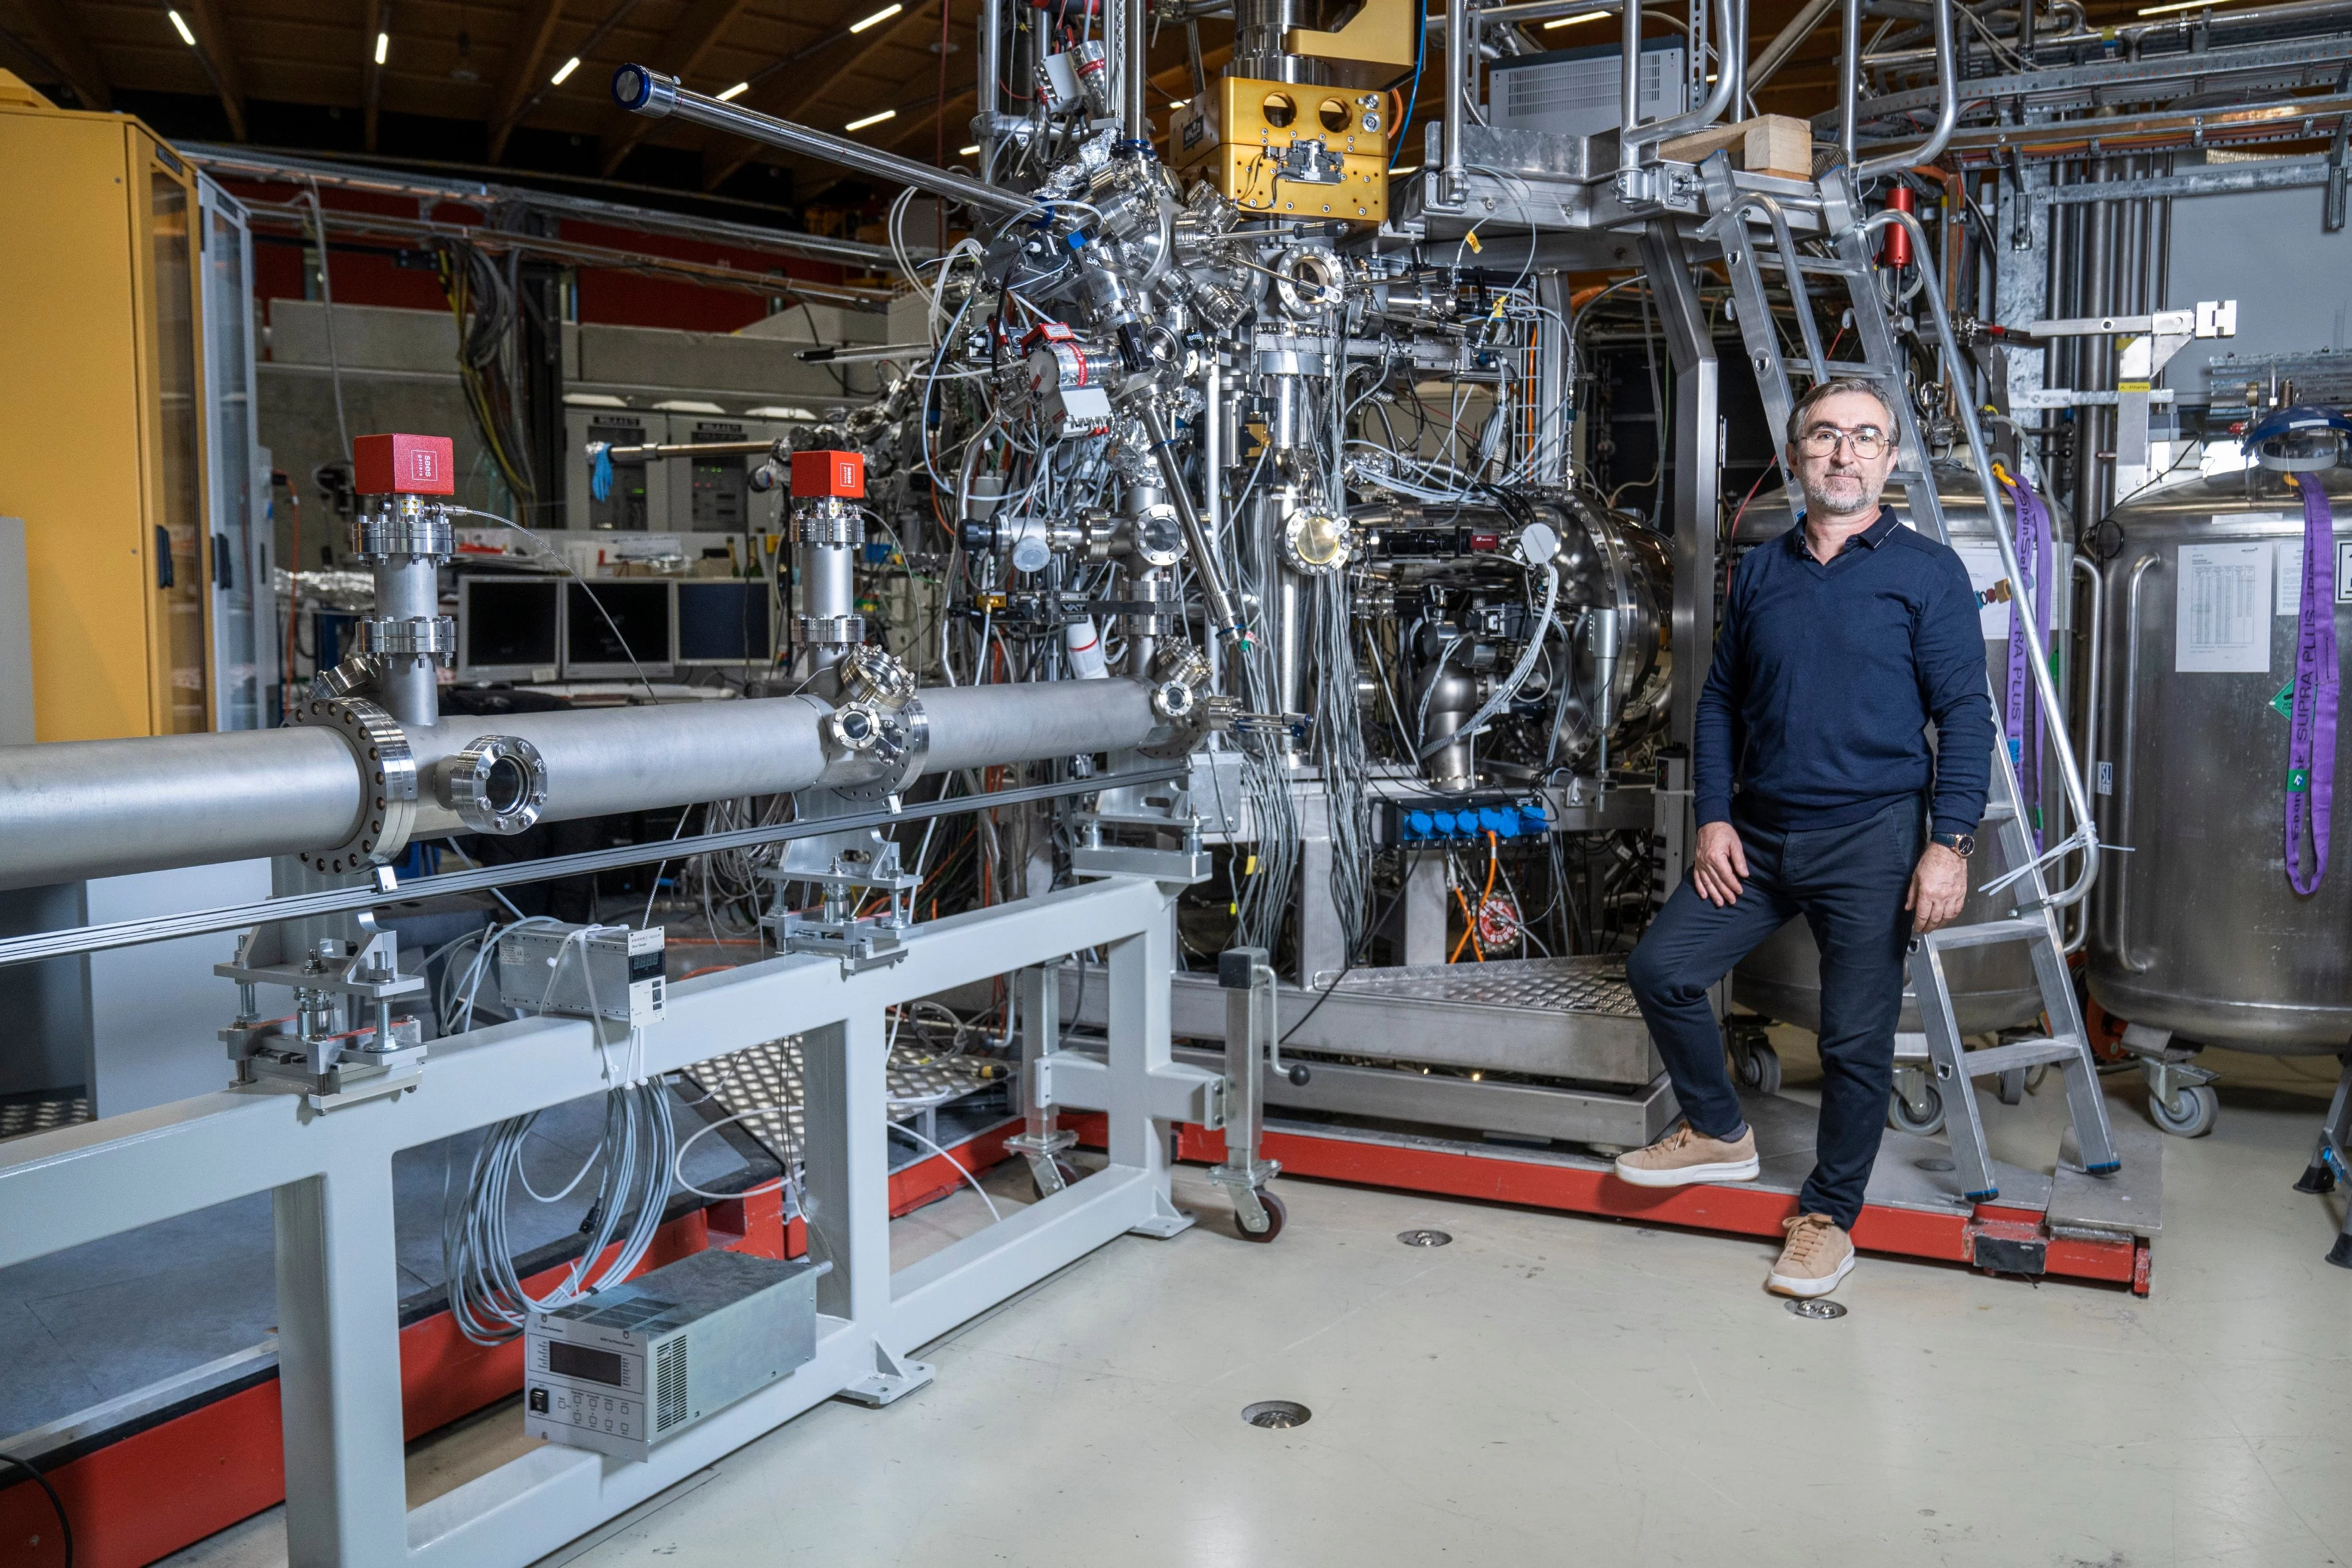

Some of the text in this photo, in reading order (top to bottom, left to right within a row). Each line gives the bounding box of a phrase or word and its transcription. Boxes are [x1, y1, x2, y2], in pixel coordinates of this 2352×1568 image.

[1086, 256, 1103, 267] VAT
[2017, 490, 2030, 577] SpanSet
[2011, 666, 2023, 720] PLUS
[2296, 670, 2313, 742] SUPRA
[2102, 765, 2110, 783] SL
